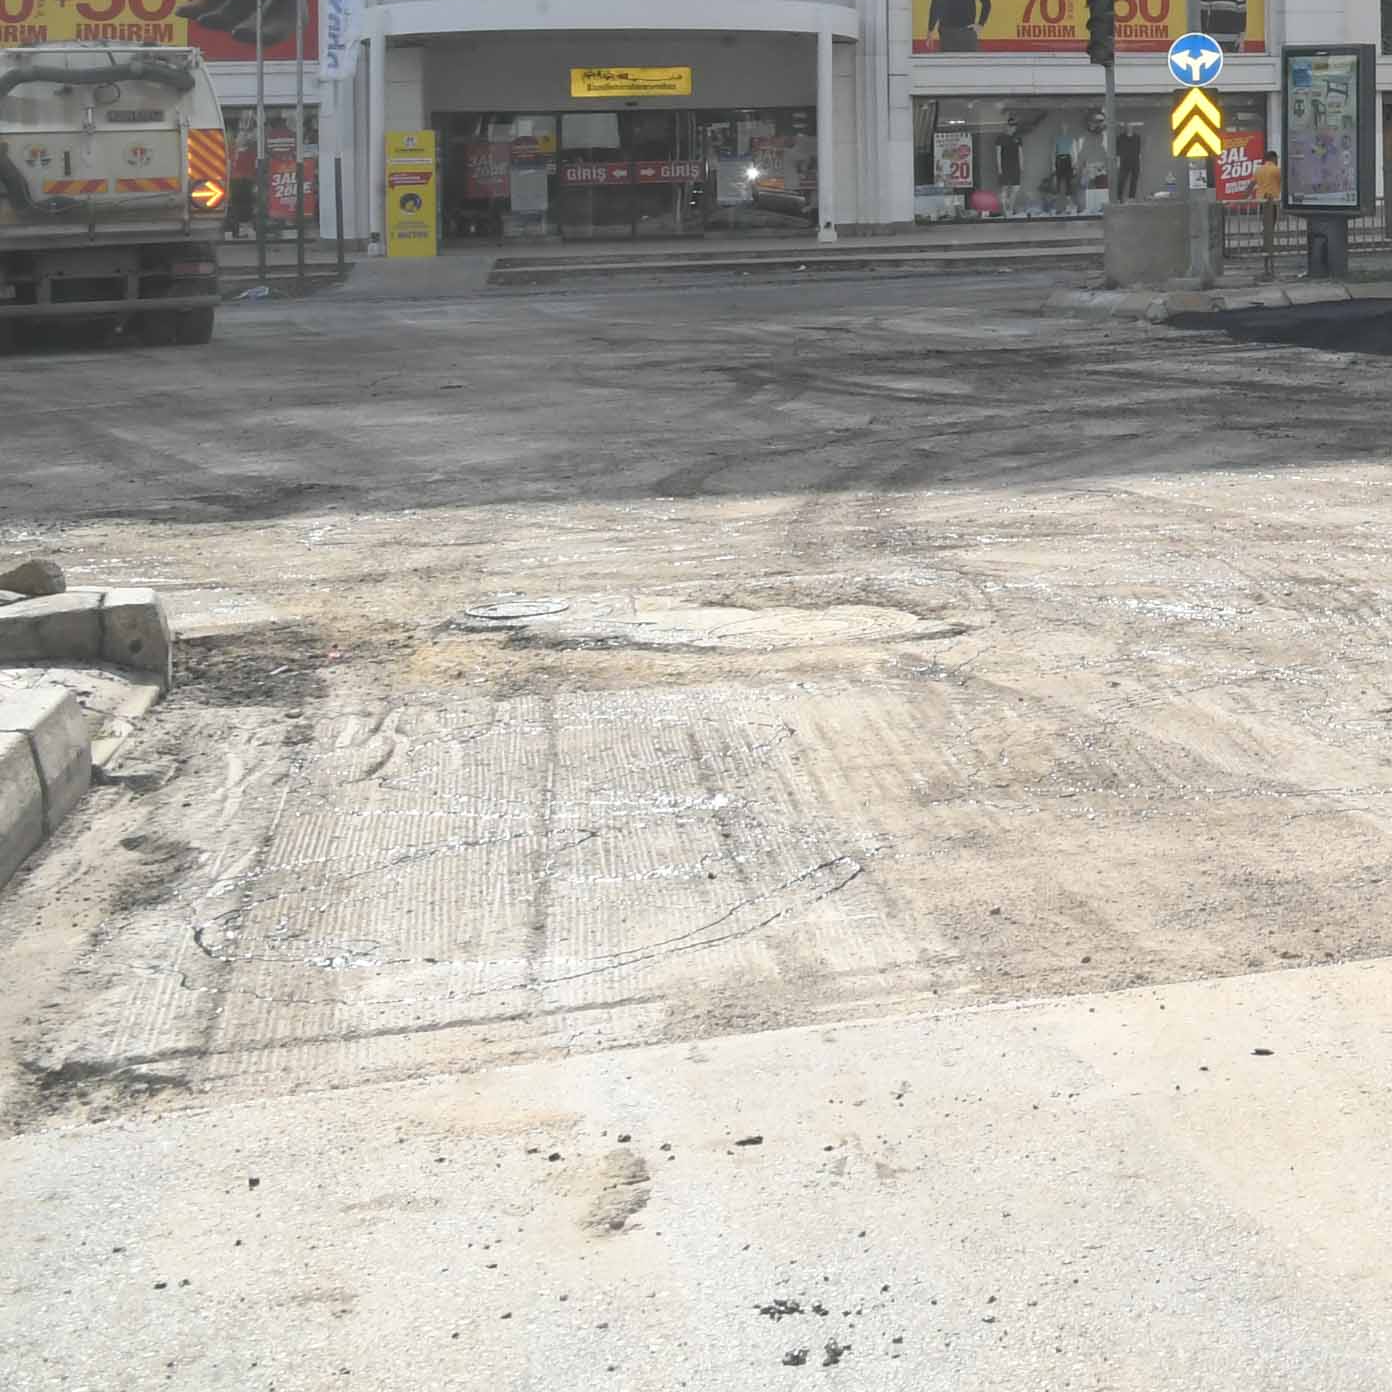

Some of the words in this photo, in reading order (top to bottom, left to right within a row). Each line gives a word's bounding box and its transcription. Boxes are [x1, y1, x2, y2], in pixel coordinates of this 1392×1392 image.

[1114, 24, 1169, 38] NDİRİM
[567, 165, 607, 182] GİRİŞ
[660, 161, 699, 179] GİRİŞ
